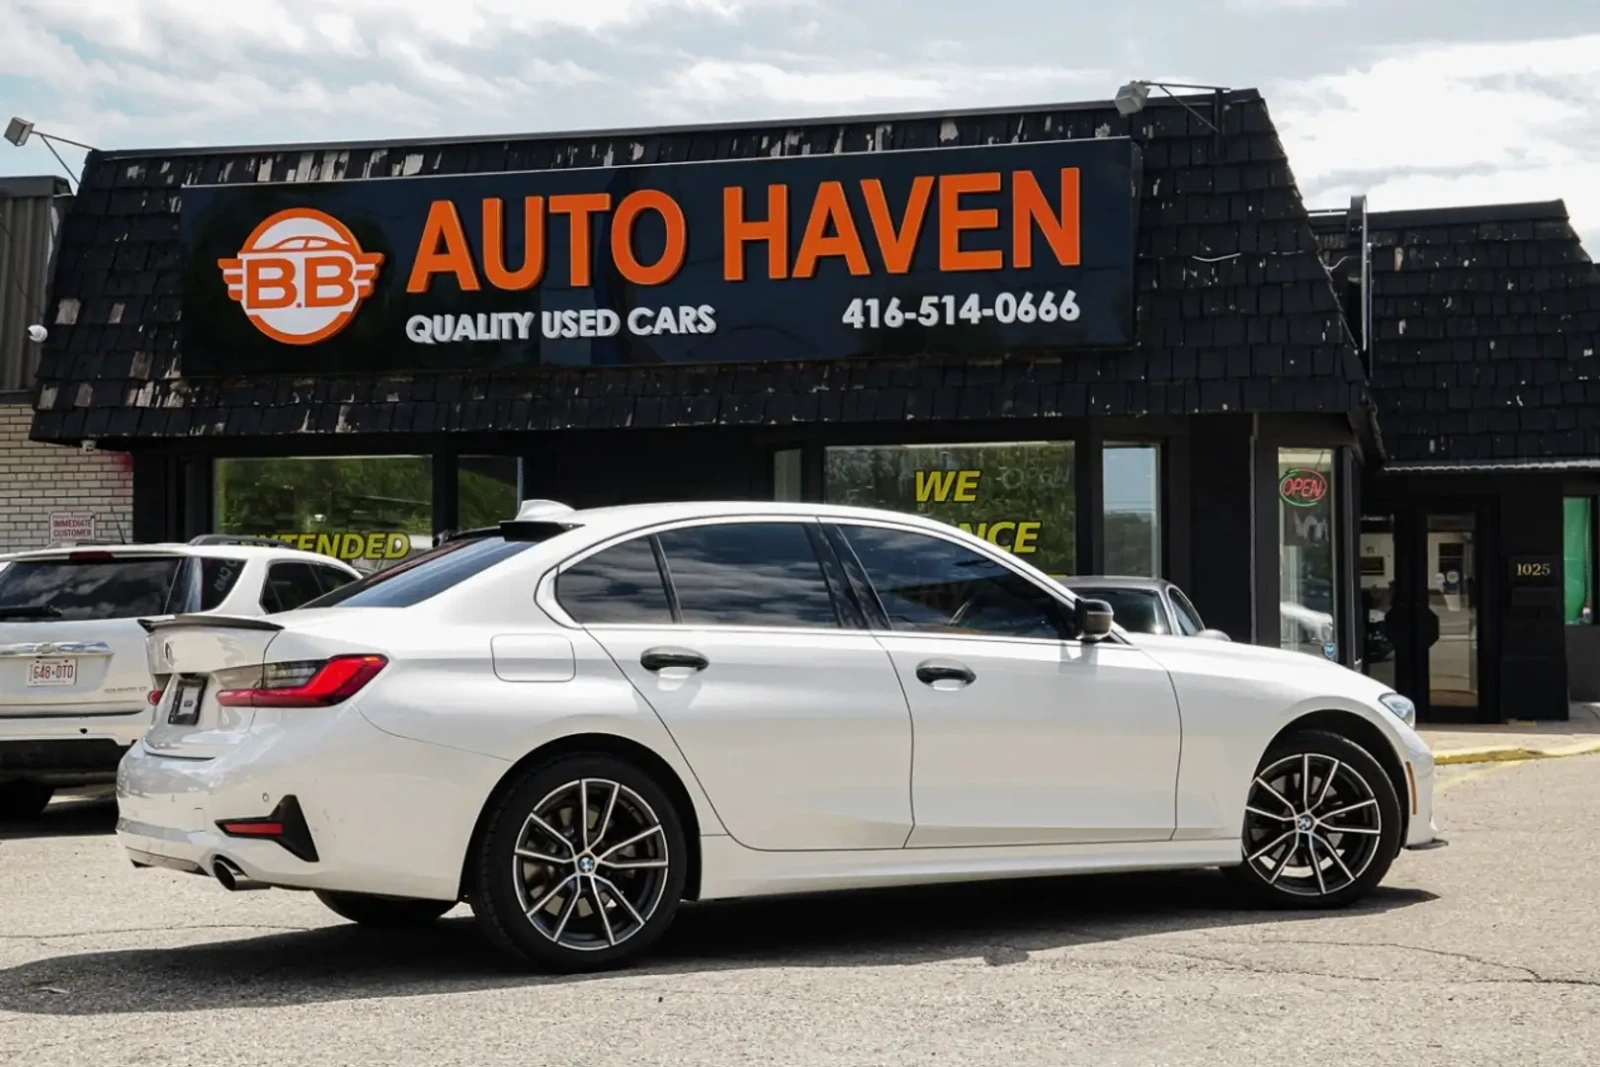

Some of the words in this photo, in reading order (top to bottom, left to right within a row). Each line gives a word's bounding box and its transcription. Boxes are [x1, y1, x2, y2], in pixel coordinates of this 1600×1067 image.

[406, 189, 687, 293] AUTO
[723, 167, 1081, 281] HAVEN
[405, 312, 535, 344] QUALITY
[541, 309, 621, 339] USED
[627, 304, 717, 337] CARS
[842, 289, 1081, 328] 416-514-0666
[914, 470, 981, 502] WE
[1282, 478, 1324, 497] OPEN
[1516, 563, 1551, 577] 1025
